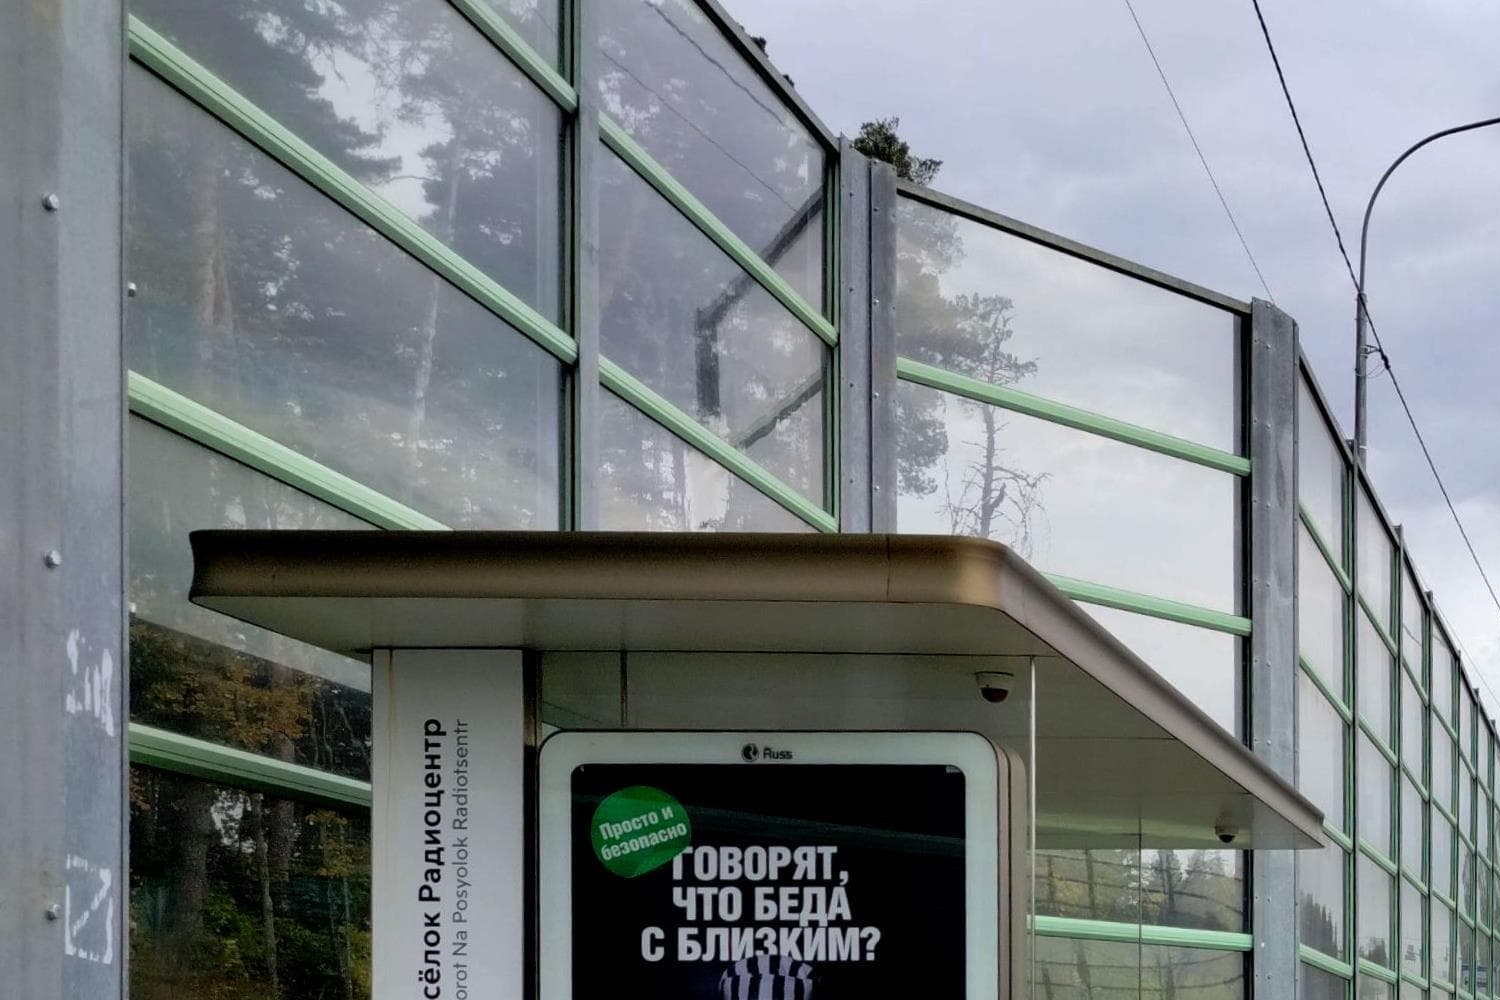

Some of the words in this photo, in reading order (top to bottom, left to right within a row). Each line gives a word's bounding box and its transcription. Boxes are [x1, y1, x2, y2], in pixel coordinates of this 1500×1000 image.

[763, 746, 793, 760] Russ
[452, 719, 469, 830] Radiotsentr
[418, 718, 447, 902] Радиоцентр
[599, 810, 660, 841] Просто
[661, 806, 675, 821] и
[600, 822, 688, 862] безопасно
[452, 836, 472, 923] Posyolok
[672, 845, 849, 886] ГОВОРЯТ,
[672, 886, 742, 922] ЧТО
[754, 886, 852, 928] БЕДА
[452, 930, 468, 956] Na
[641, 926, 665, 962] С
[677, 926, 882, 962] БЛИЗКИМ?
